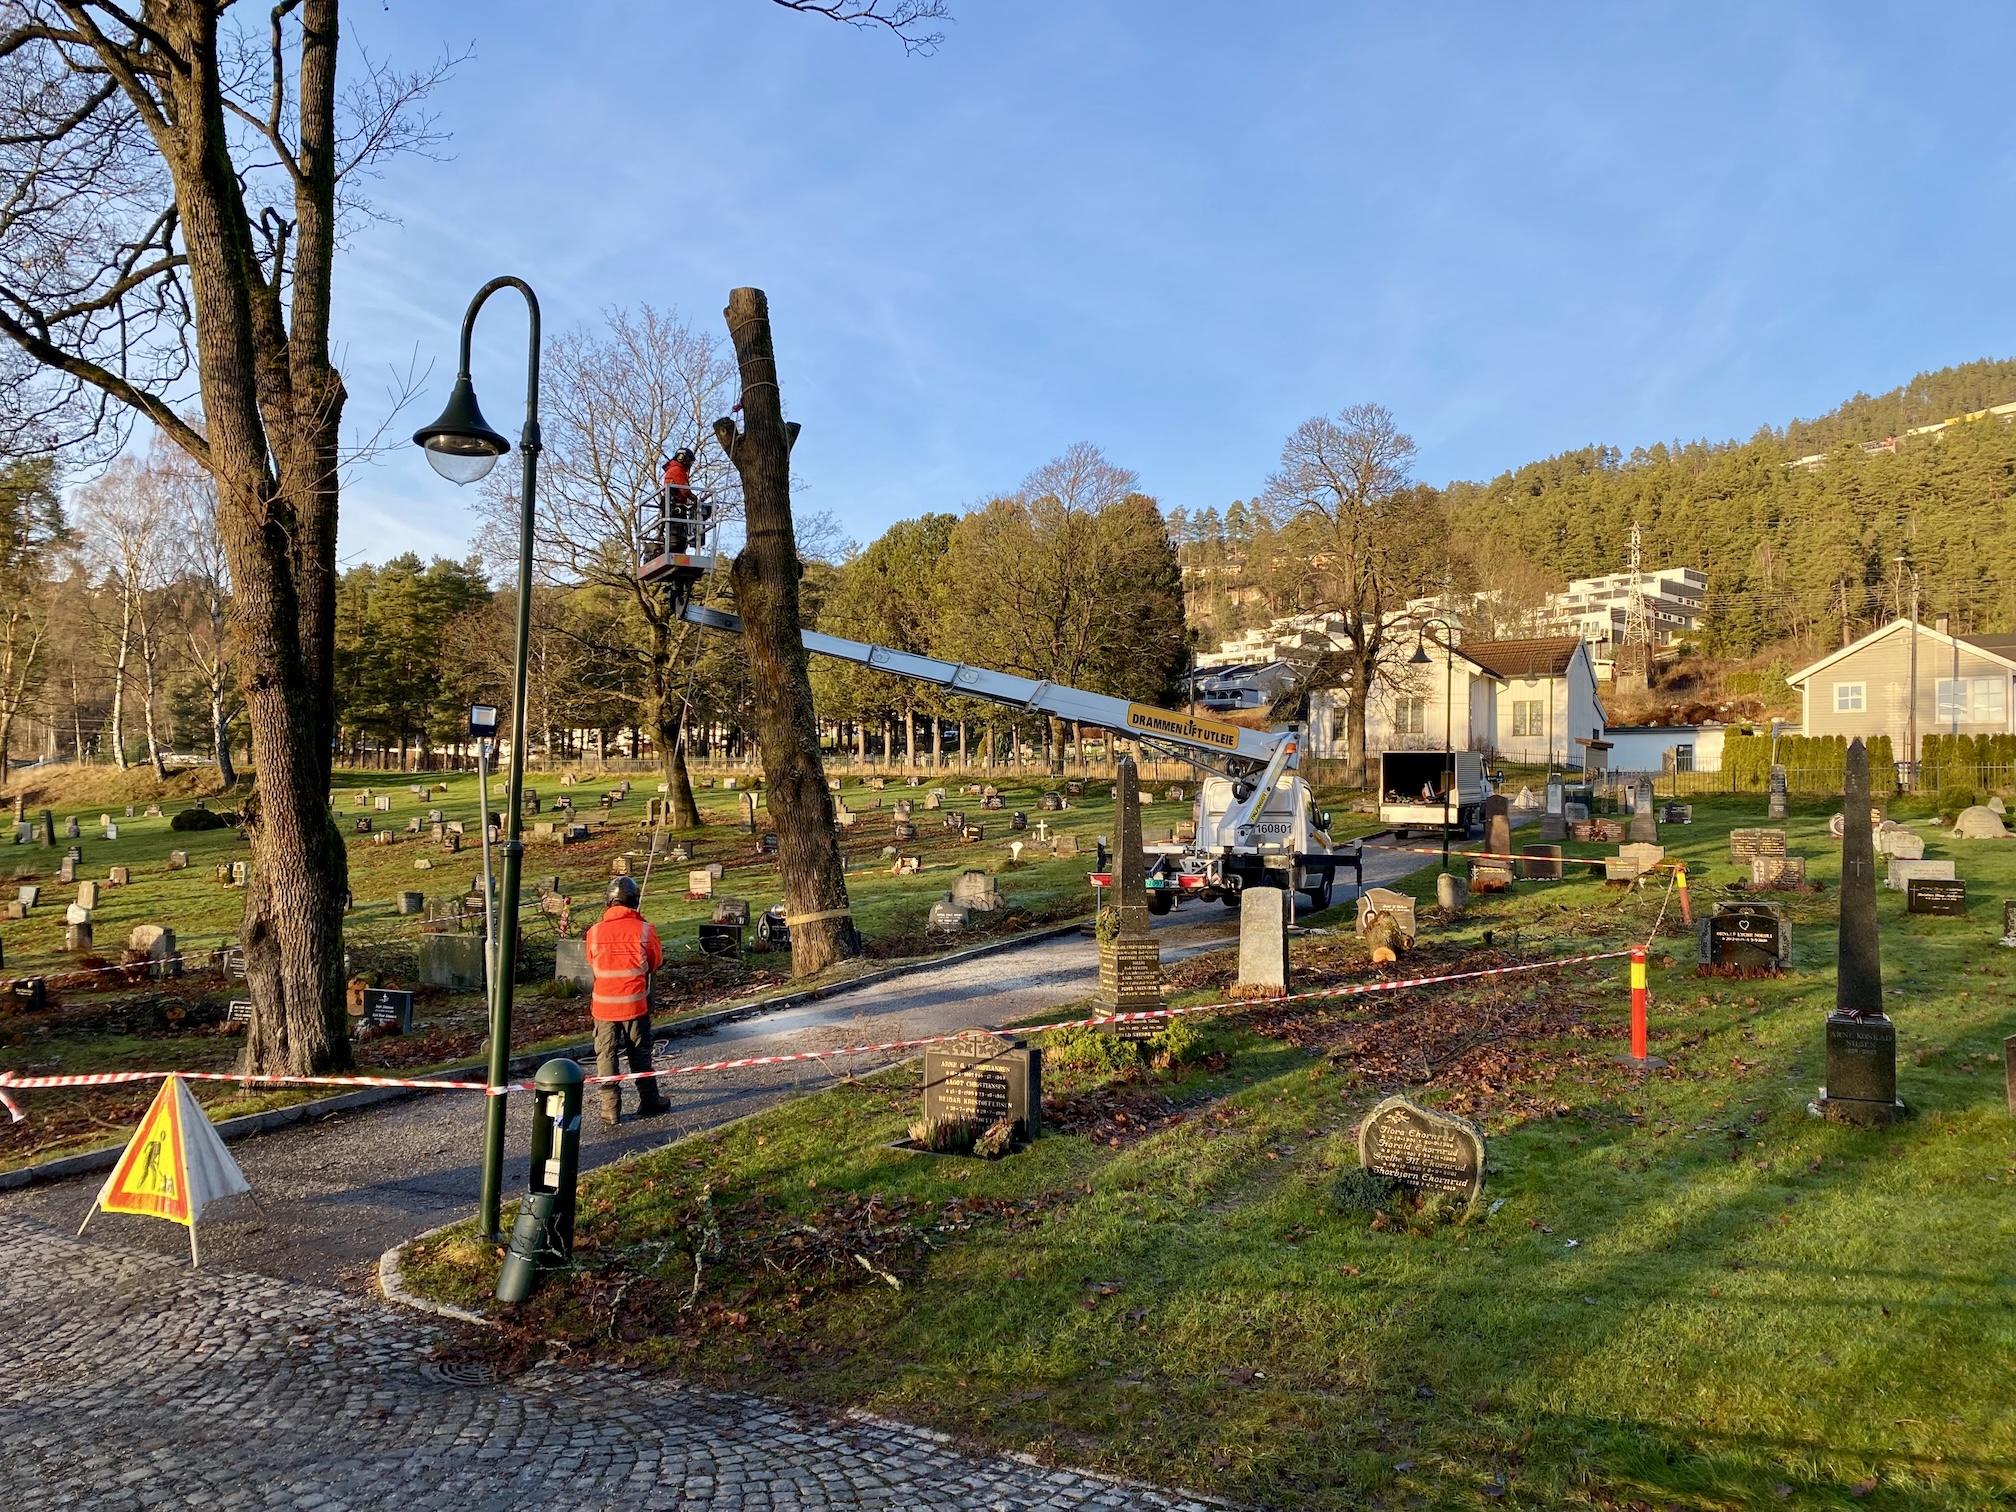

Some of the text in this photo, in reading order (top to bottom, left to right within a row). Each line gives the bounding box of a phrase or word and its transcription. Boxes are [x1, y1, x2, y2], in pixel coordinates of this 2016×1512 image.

[1132, 713, 1183, 734] DRAMMEN
[1204, 730, 1234, 746] UTLEIE
[1250, 792, 1266, 821] PALFINGER
[1256, 824, 1292, 834] 160801
[1856, 1032, 1892, 1042] KONRAD
[1846, 1040, 1876, 1048] NILSEN
[938, 1096, 961, 1104] REIDAR
[1378, 1139, 1412, 1150] Harald
